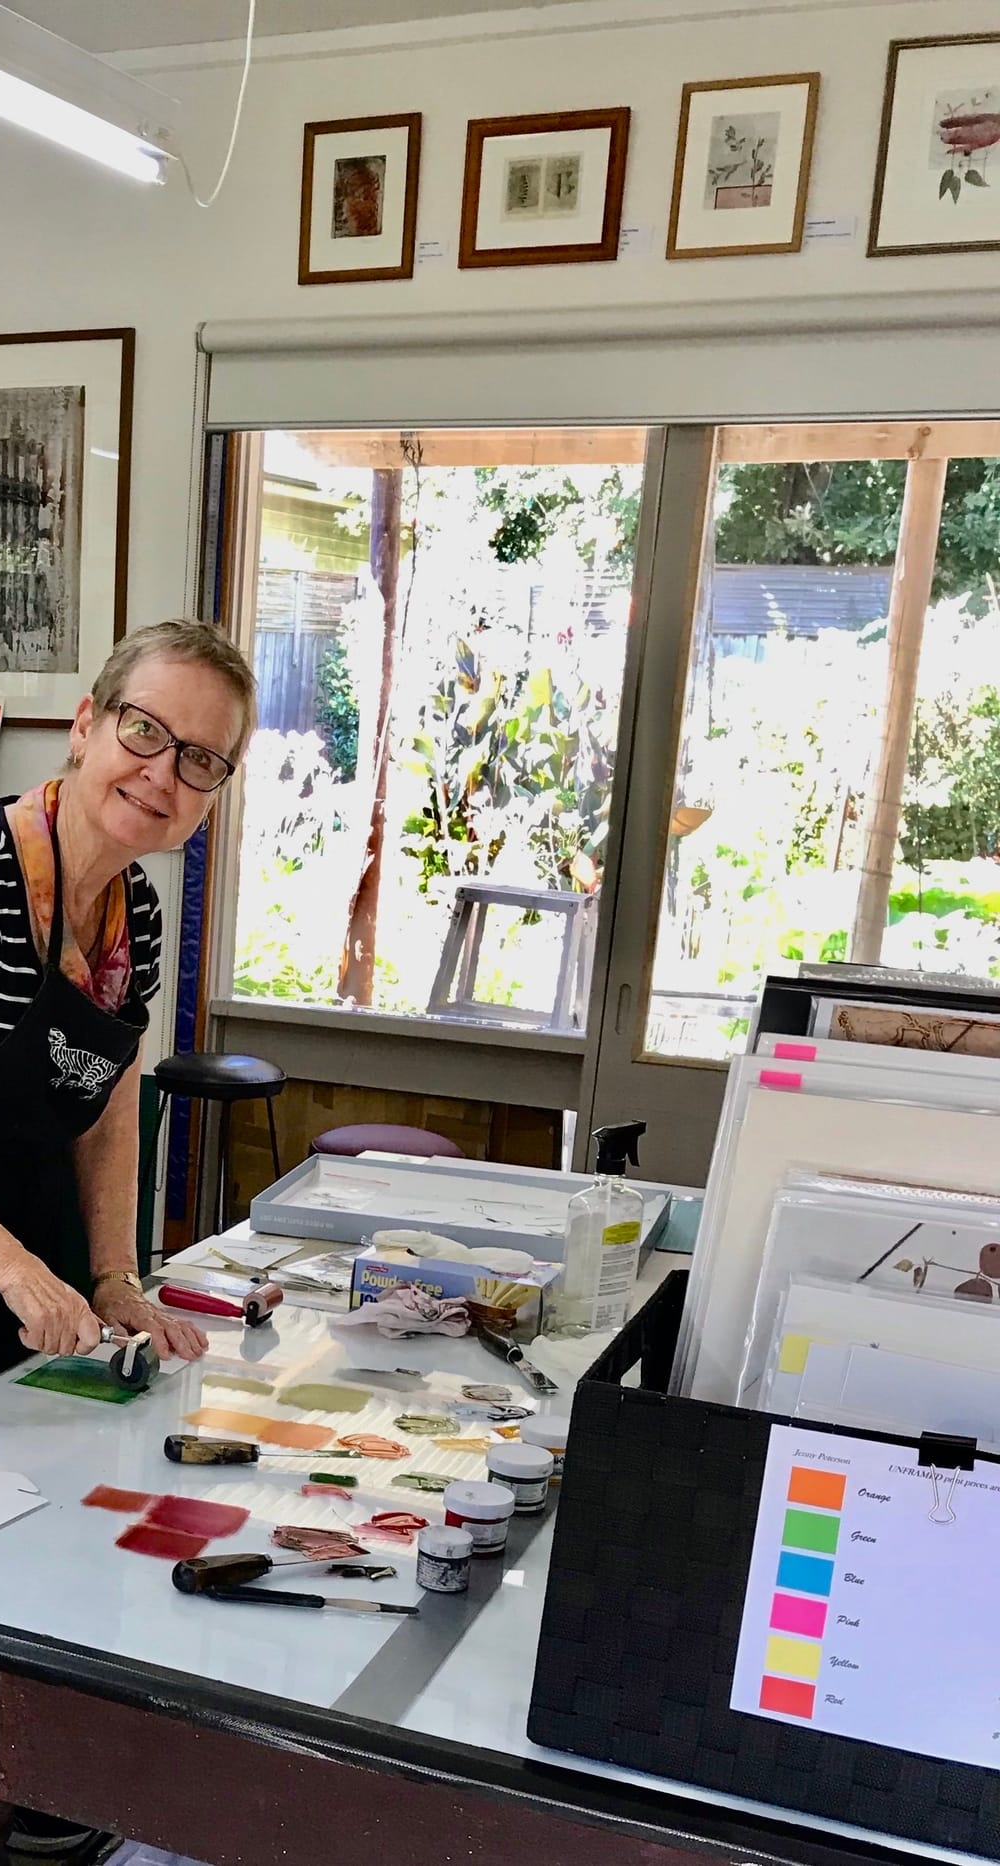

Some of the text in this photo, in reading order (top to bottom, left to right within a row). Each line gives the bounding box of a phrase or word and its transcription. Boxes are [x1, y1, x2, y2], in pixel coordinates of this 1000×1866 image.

[943, 1476, 964, 1485] prnt
[857, 1488, 891, 1503] Orange
[850, 1530, 877, 1544] Green
[843, 1572, 865, 1585] Blue
[836, 1614, 860, 1628] Pink
[829, 1655, 860, 1669] Yellow
[823, 1693, 846, 1706] Red
